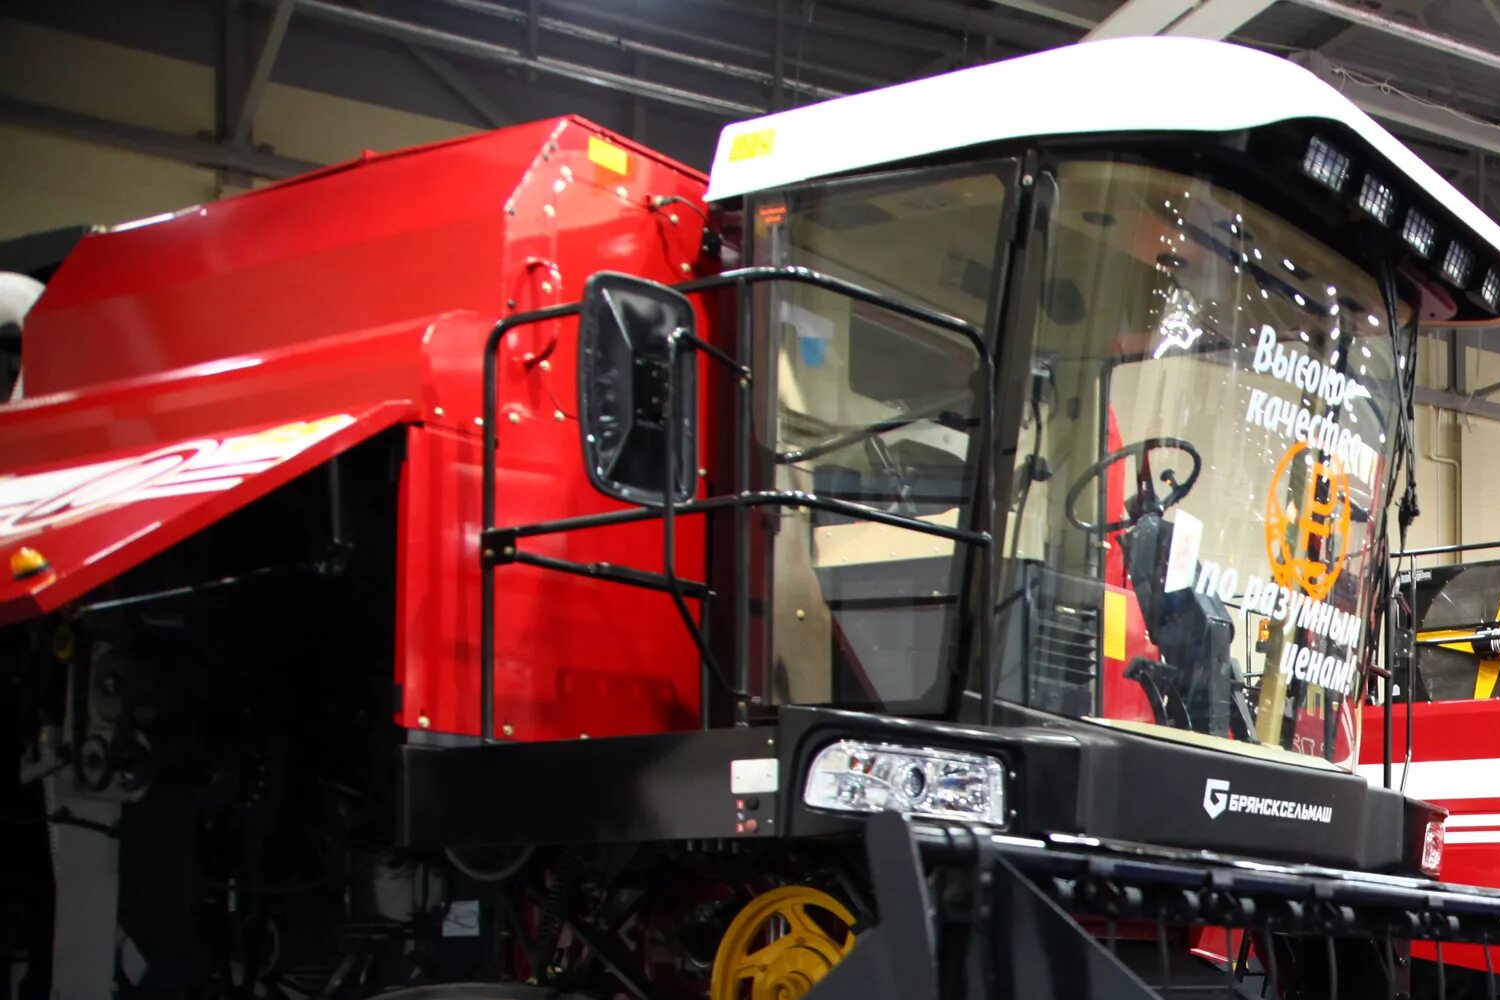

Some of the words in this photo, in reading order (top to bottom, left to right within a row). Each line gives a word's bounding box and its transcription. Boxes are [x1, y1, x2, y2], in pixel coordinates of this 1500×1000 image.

[1253, 324, 1357, 412] Высокое
[1196, 560, 1238, 601] по
[1240, 574, 1362, 648] разумным
[1279, 642, 1357, 696] ценам!
[1228, 793, 1333, 823] БРЯНСКСЕЛЬМАШ
